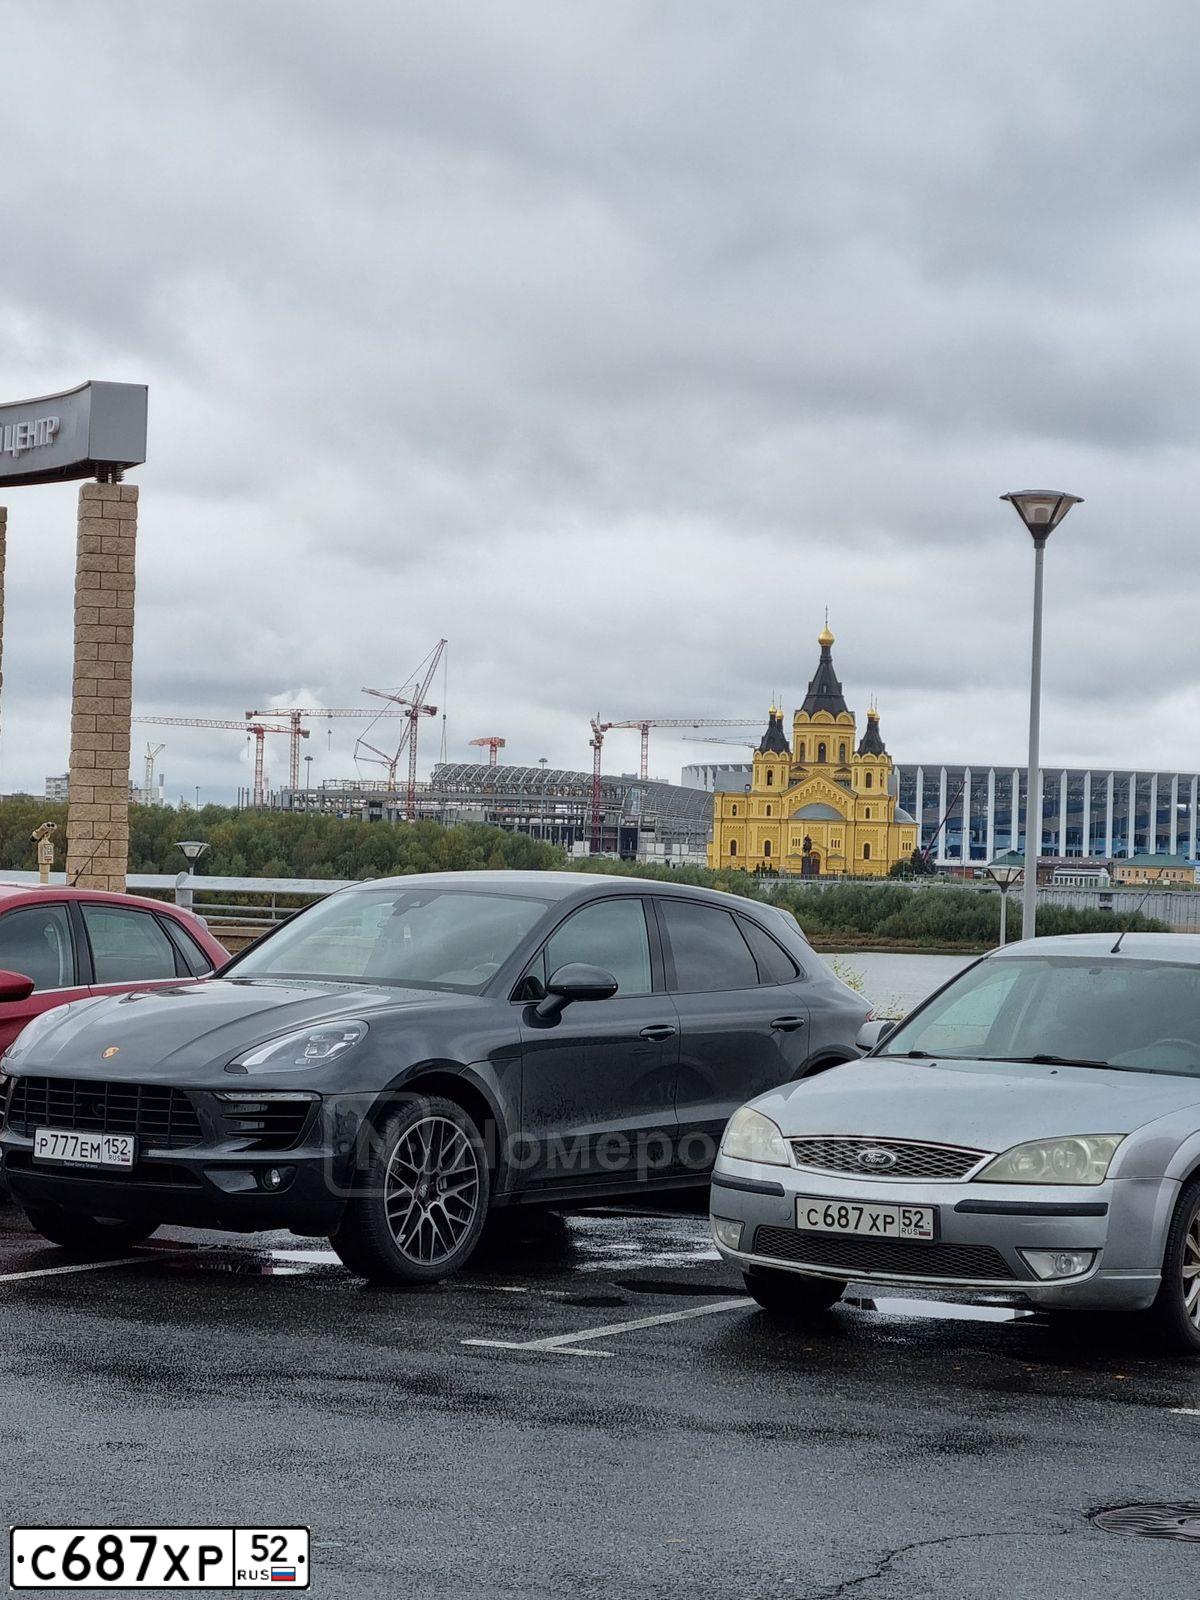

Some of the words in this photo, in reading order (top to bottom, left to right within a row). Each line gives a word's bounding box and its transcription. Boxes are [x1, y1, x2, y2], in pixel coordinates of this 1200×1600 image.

[0, 416, 60, 458] ЦЕНТР
[39, 1134, 101, 1159] Р777ЕМ
[104, 1138, 128, 1155] 152
[865, 1153, 886, 1163] Ford
[807, 1205, 895, 1233] С687ХР
[902, 1210, 924, 1229] 52
[901, 1228, 918, 1236] RUS
